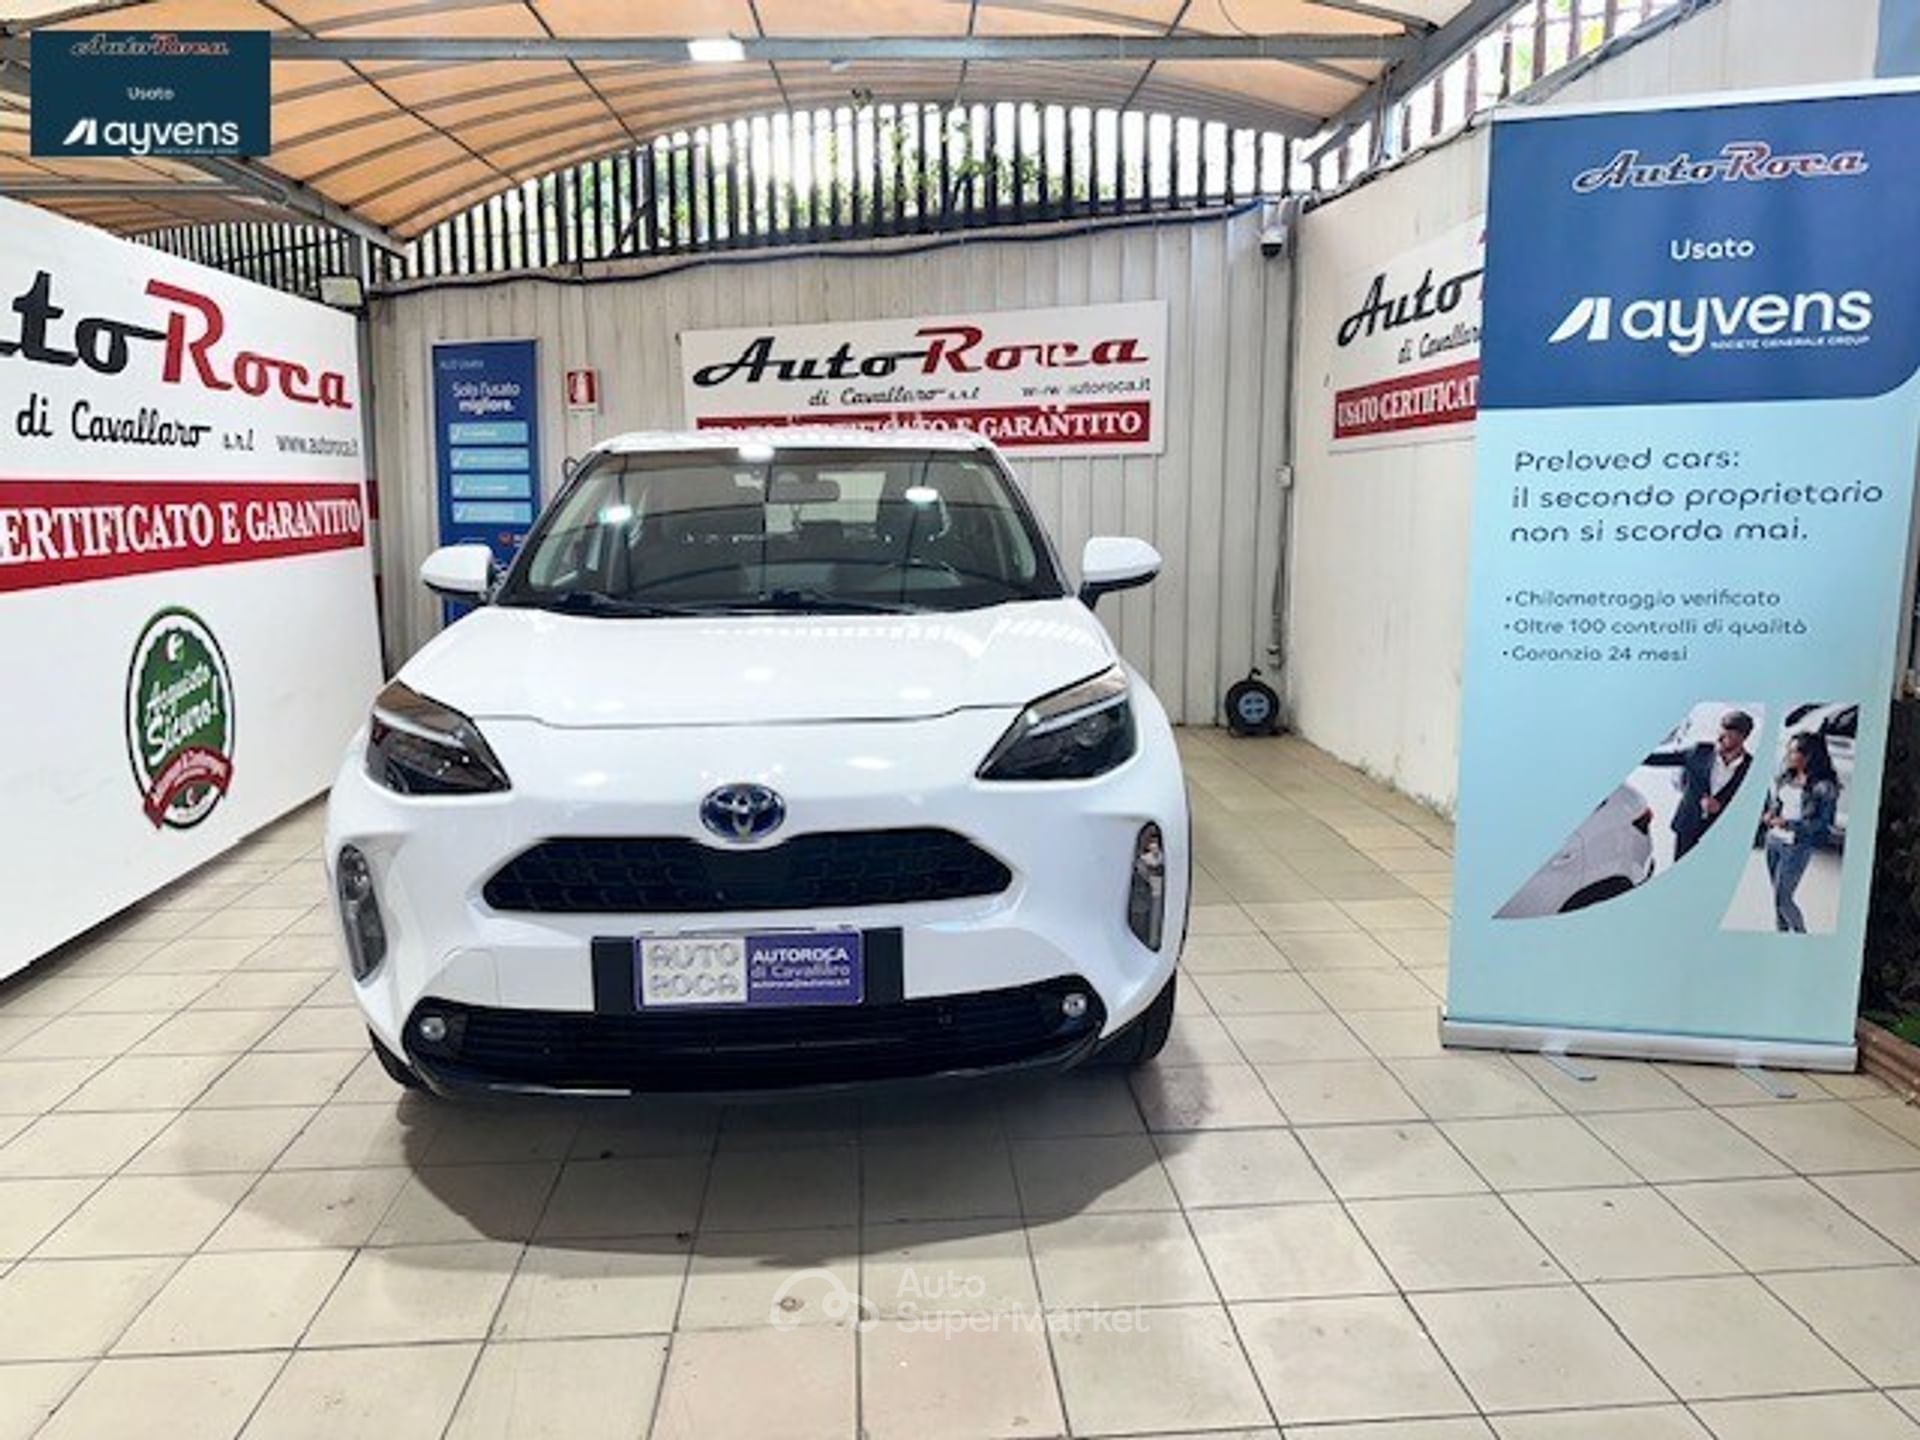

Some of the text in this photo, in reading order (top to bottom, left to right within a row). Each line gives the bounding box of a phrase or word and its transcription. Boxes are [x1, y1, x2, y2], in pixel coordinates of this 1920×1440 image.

[1670, 239, 1755, 261] Usato
[1621, 290, 1873, 357] ayvens
[808, 389, 831, 407] di
[839, 386, 945, 406] Cavallaro
[17, 393, 52, 437] di
[71, 400, 211, 448] Cavallaro
[978, 410, 1142, 438] GARANTITO
[1338, 395, 1379, 428] USATO
[1514, 448, 1740, 473] Preloved cars:
[1511, 480, 1884, 511] il secondo proprietario
[222, 503, 241, 545] E
[246, 498, 362, 543] GARANTITO
[1510, 517, 1808, 543] non si scorda mai.
[1514, 589, 1781, 610] Chilometraggio verificato
[1513, 618, 1564, 635] Oltre
[1570, 618, 1605, 634] 100
[1610, 618, 1697, 634] controlli
[1703, 618, 1723, 634] di
[1511, 644, 1688, 662] Garanzia 24 mesi
[649, 941, 849, 969] AUTO AUTOROCA
[650, 973, 741, 998] ROCA
